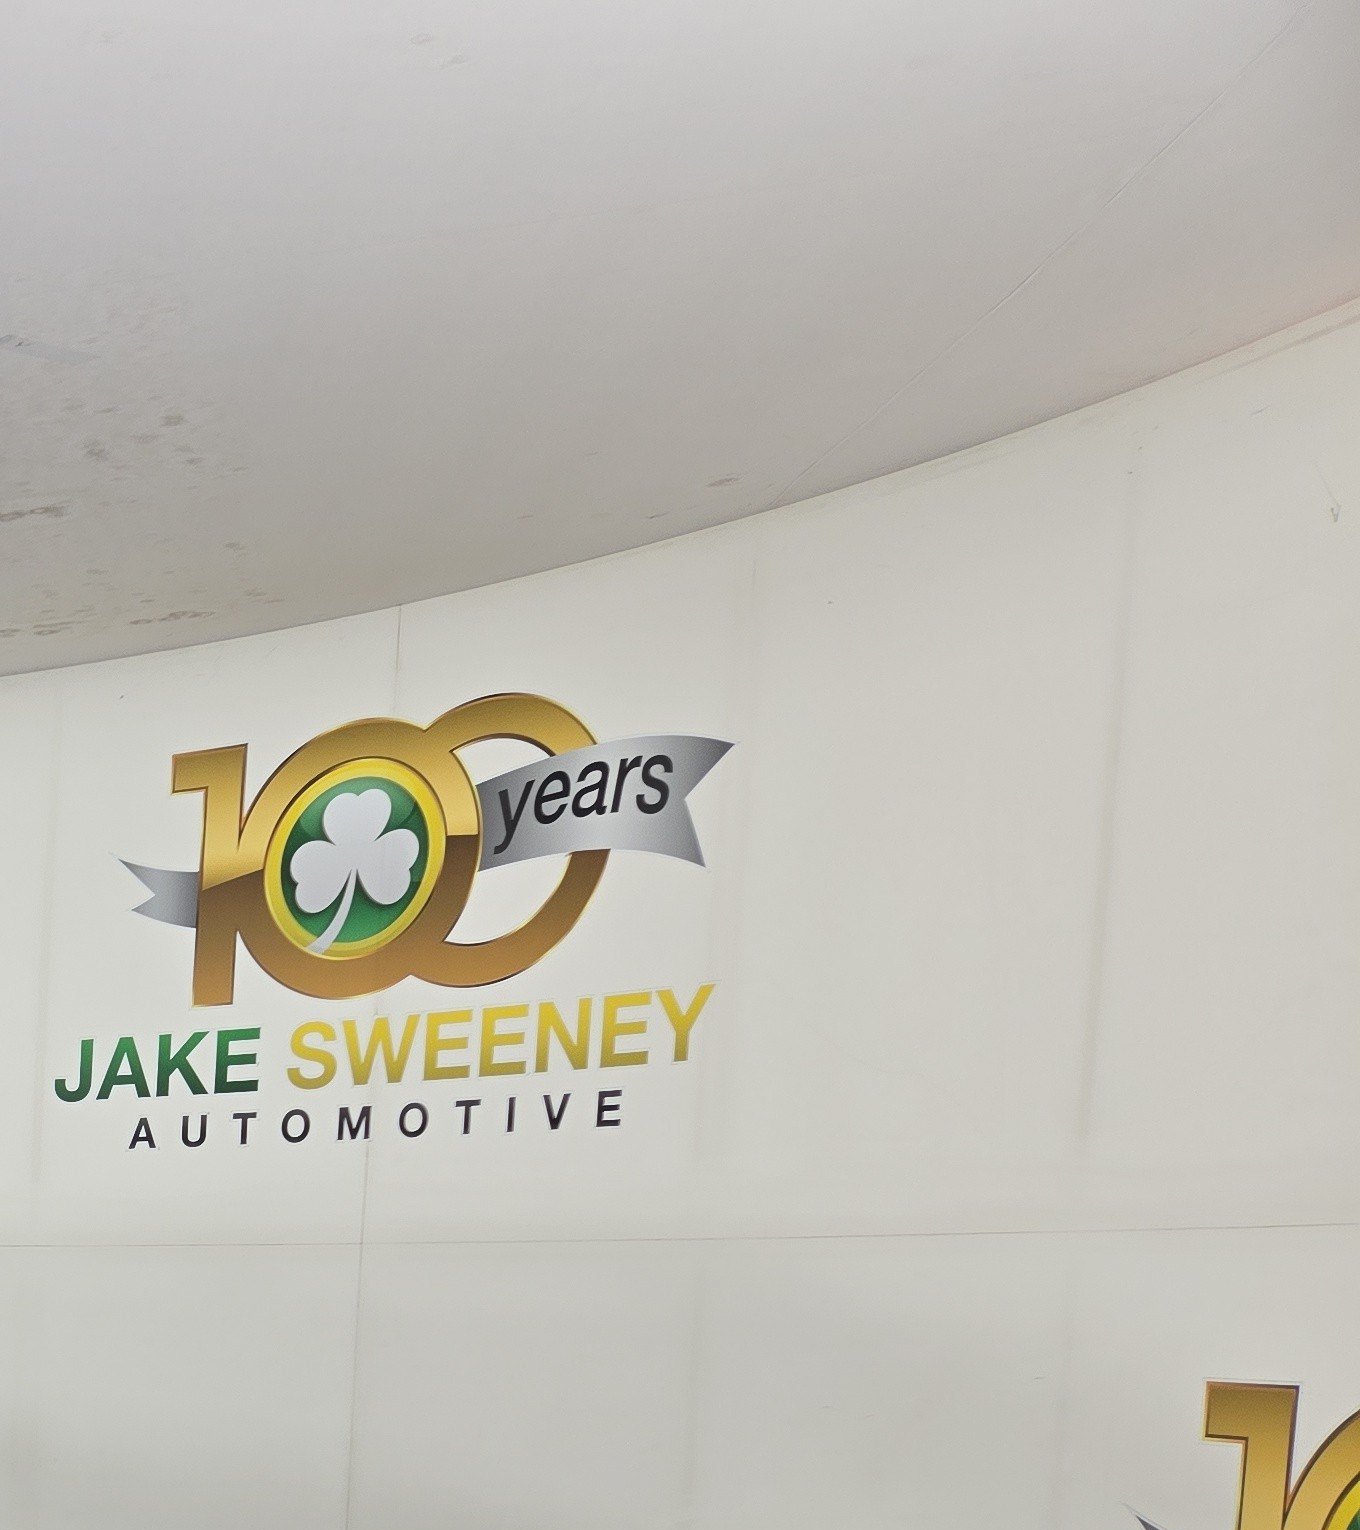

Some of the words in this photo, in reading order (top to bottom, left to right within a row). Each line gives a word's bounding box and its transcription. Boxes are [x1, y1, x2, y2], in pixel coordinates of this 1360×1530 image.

[492, 752, 674, 855] years
[54, 1027, 261, 1102] JAKE
[287, 983, 716, 1090] SWEENEY
[128, 1089, 624, 1150] AUTOMOTIVE
